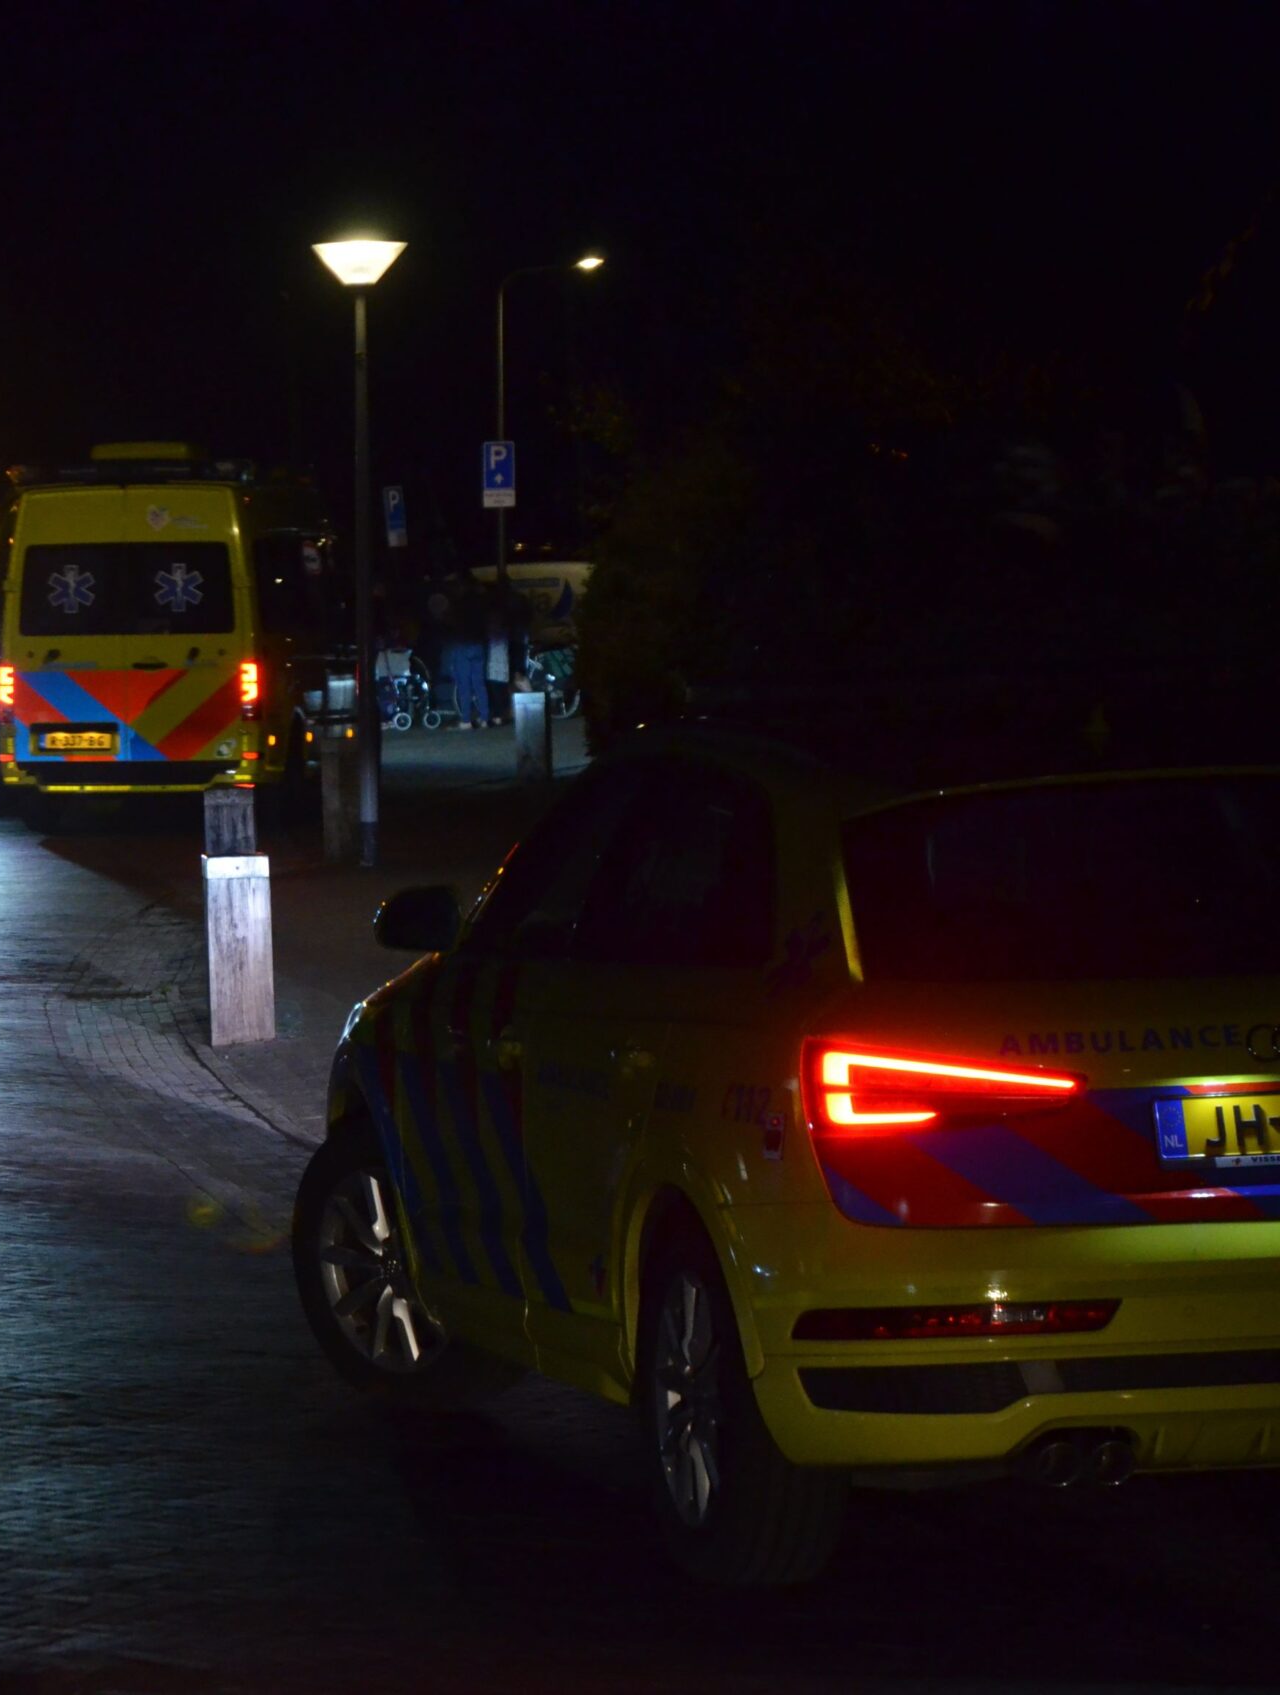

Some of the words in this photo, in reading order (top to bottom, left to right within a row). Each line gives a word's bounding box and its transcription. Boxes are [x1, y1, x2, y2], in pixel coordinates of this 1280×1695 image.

[490, 446, 507, 470] P
[388, 490, 400, 512] P
[1000, 1024, 1242, 1056] AMBULANCE
[1164, 1135, 1184, 1149] NL
